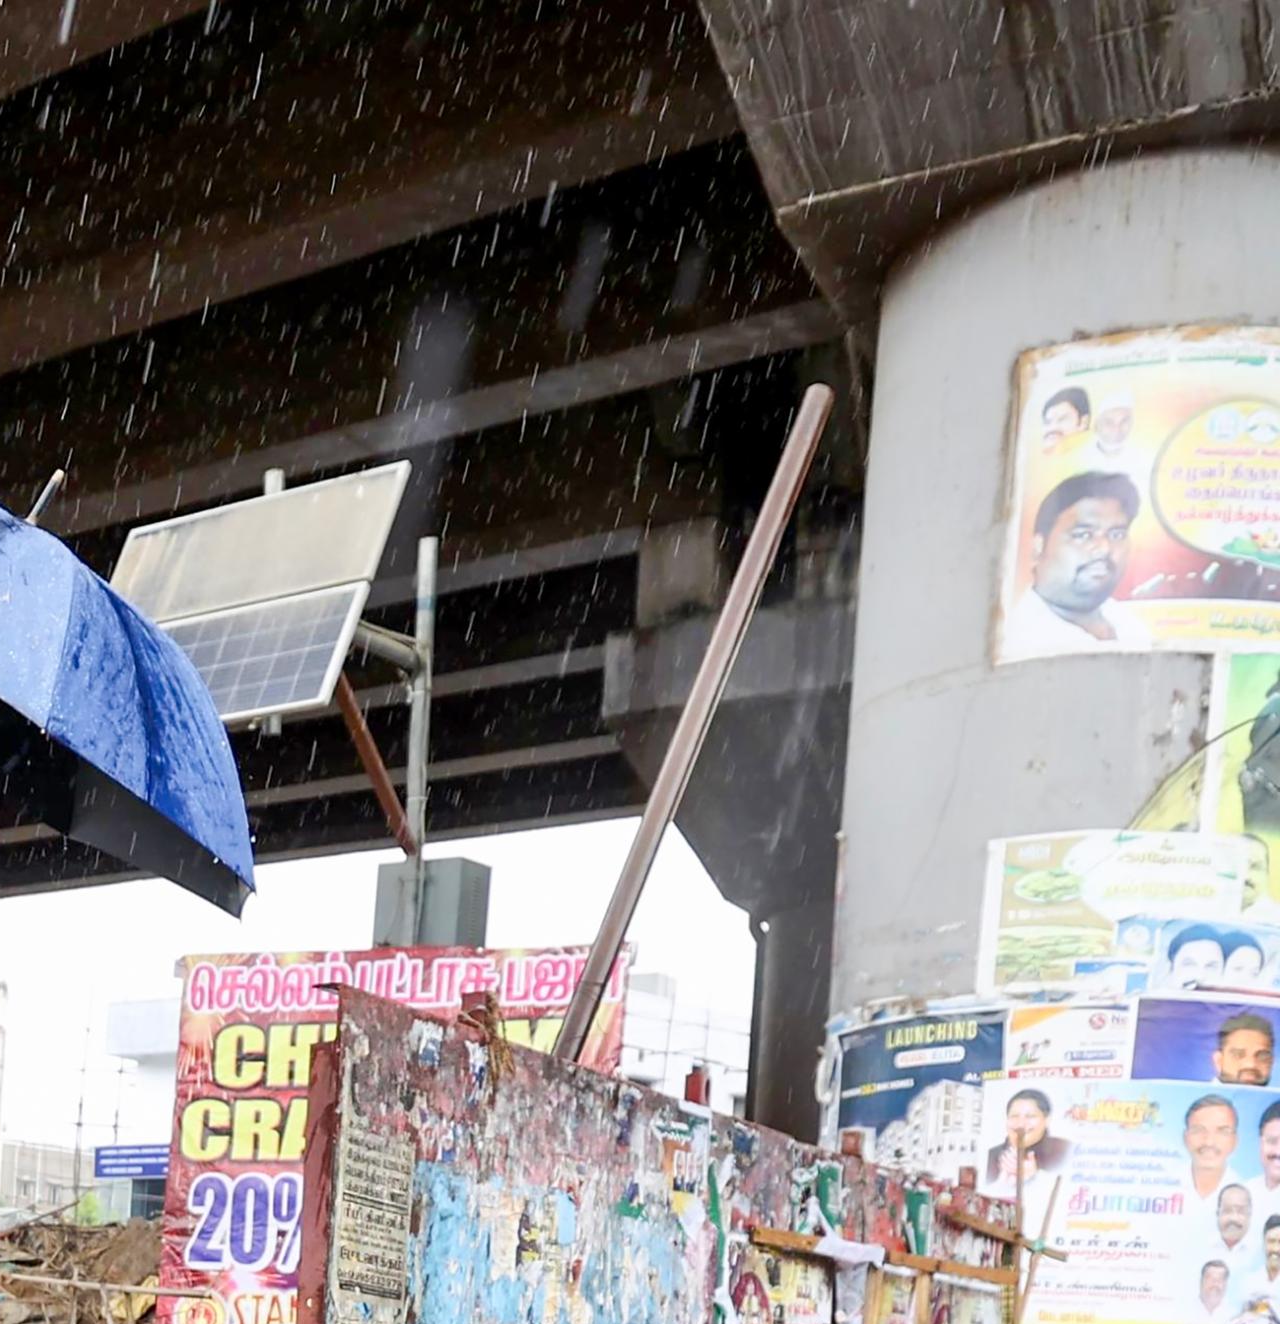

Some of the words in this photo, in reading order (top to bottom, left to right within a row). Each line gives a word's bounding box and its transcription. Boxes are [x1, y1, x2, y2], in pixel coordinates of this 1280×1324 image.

[190, 951, 349, 1011] செல்லம்
[215, 1024, 338, 1087] CH
[188, 1175, 303, 1268] 20%
[1067, 1187, 1184, 1216] தீபாவளி
